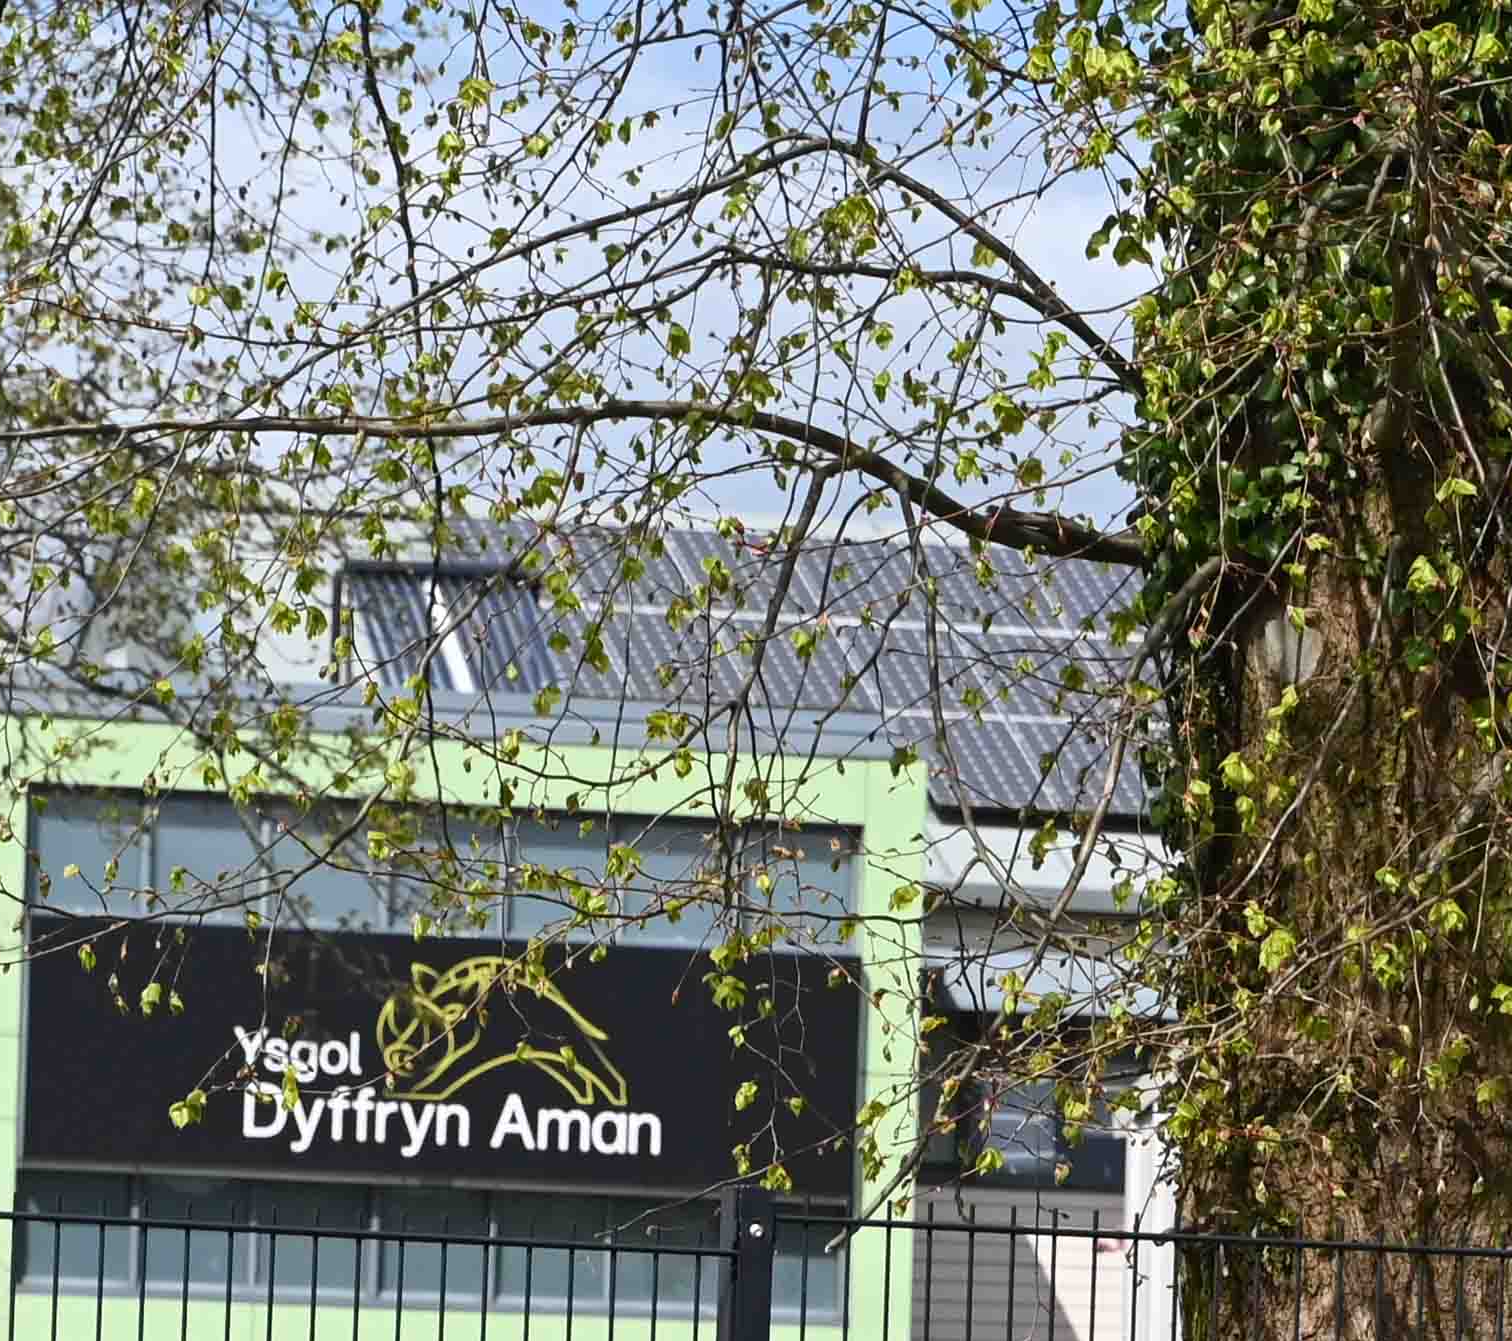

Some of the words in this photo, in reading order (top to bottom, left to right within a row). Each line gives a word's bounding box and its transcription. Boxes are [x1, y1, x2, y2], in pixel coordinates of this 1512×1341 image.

[233, 1024, 363, 1083] Ysgol
[241, 1081, 471, 1159] Dyffryn
[488, 1092, 663, 1157] Aman
